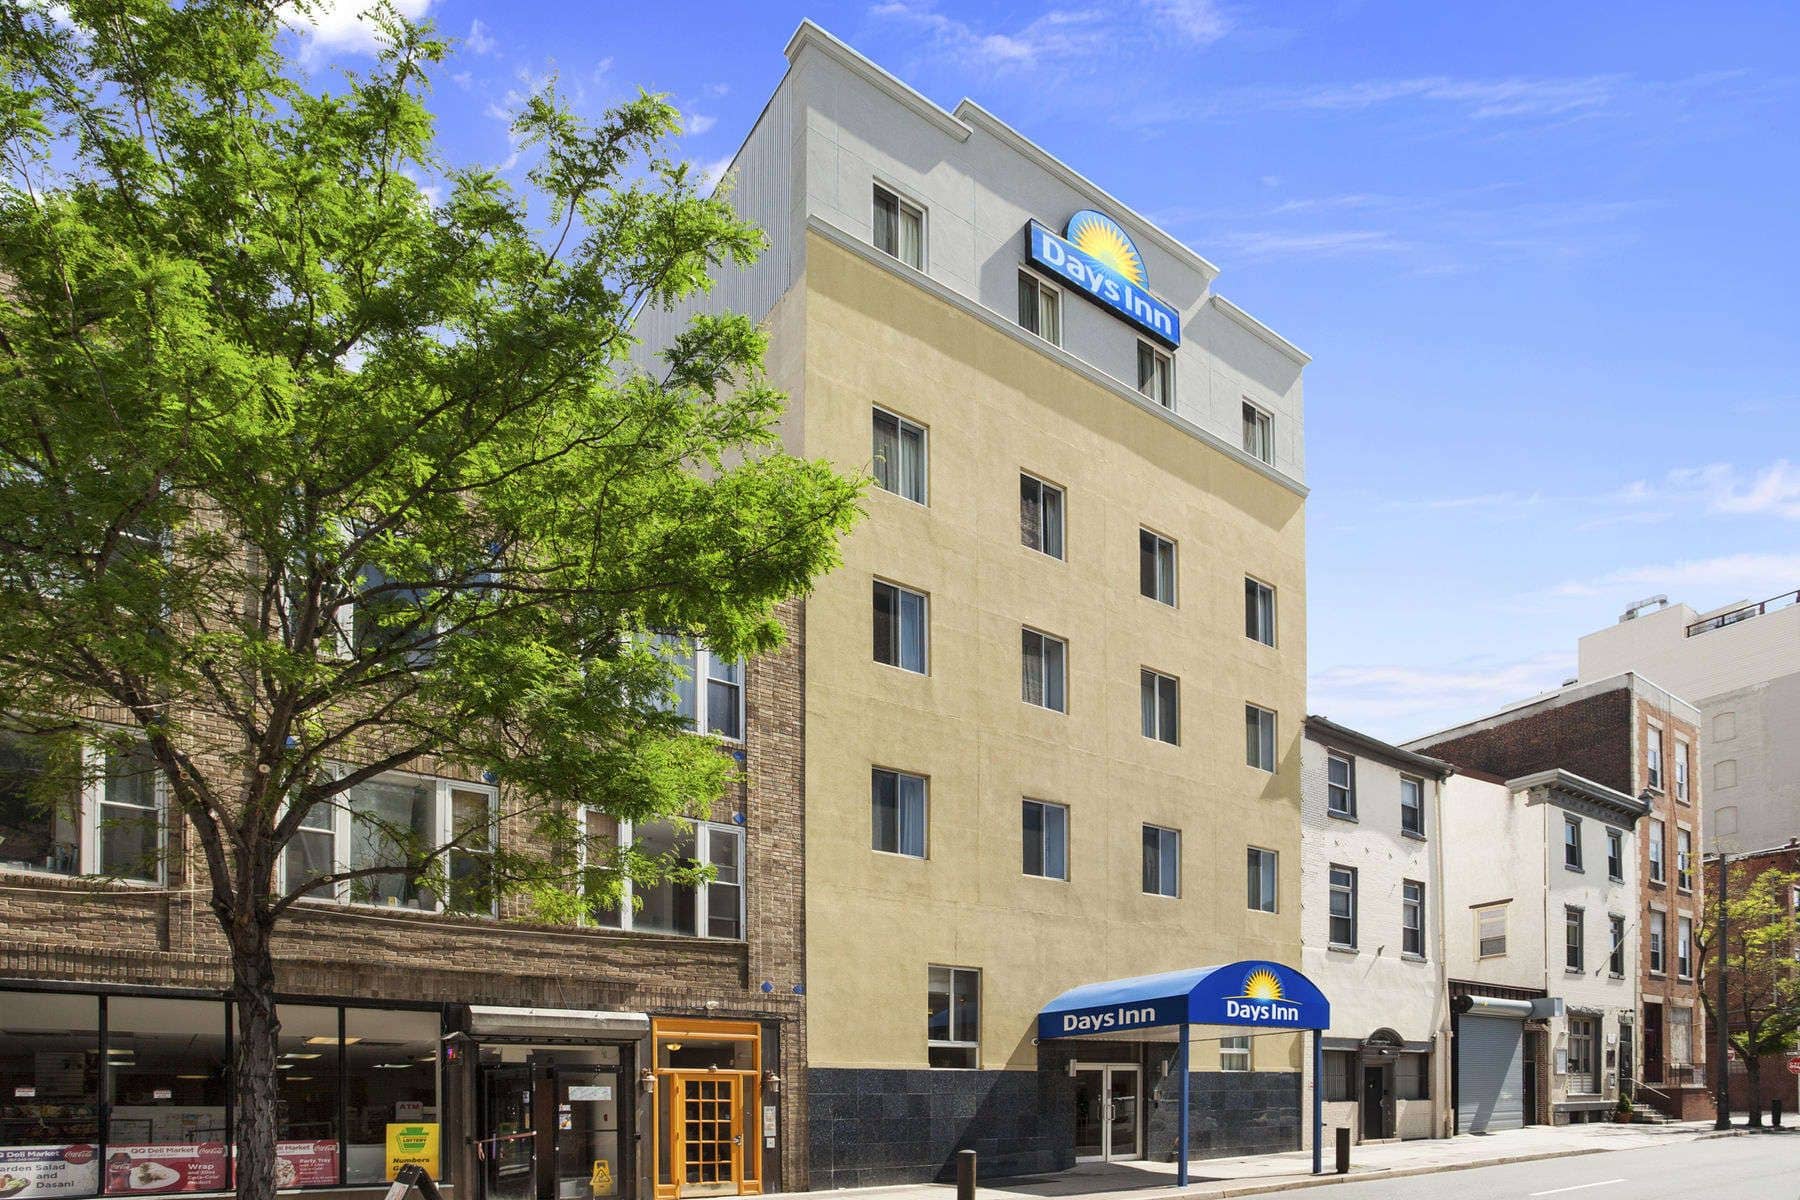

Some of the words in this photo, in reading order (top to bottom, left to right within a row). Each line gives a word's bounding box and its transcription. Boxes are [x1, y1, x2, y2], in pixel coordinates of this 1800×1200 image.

[1042, 233, 1120, 302] Days
[1125, 286, 1172, 335] Inn
[1063, 1013, 1115, 1031] Days
[1118, 1008, 1156, 1025] Inn
[1226, 1000, 1270, 1021] Days
[1271, 1003, 1299, 1021] Inn
[36, 1163, 66, 1171] Salad
[36, 1180, 75, 1189] Dasani
